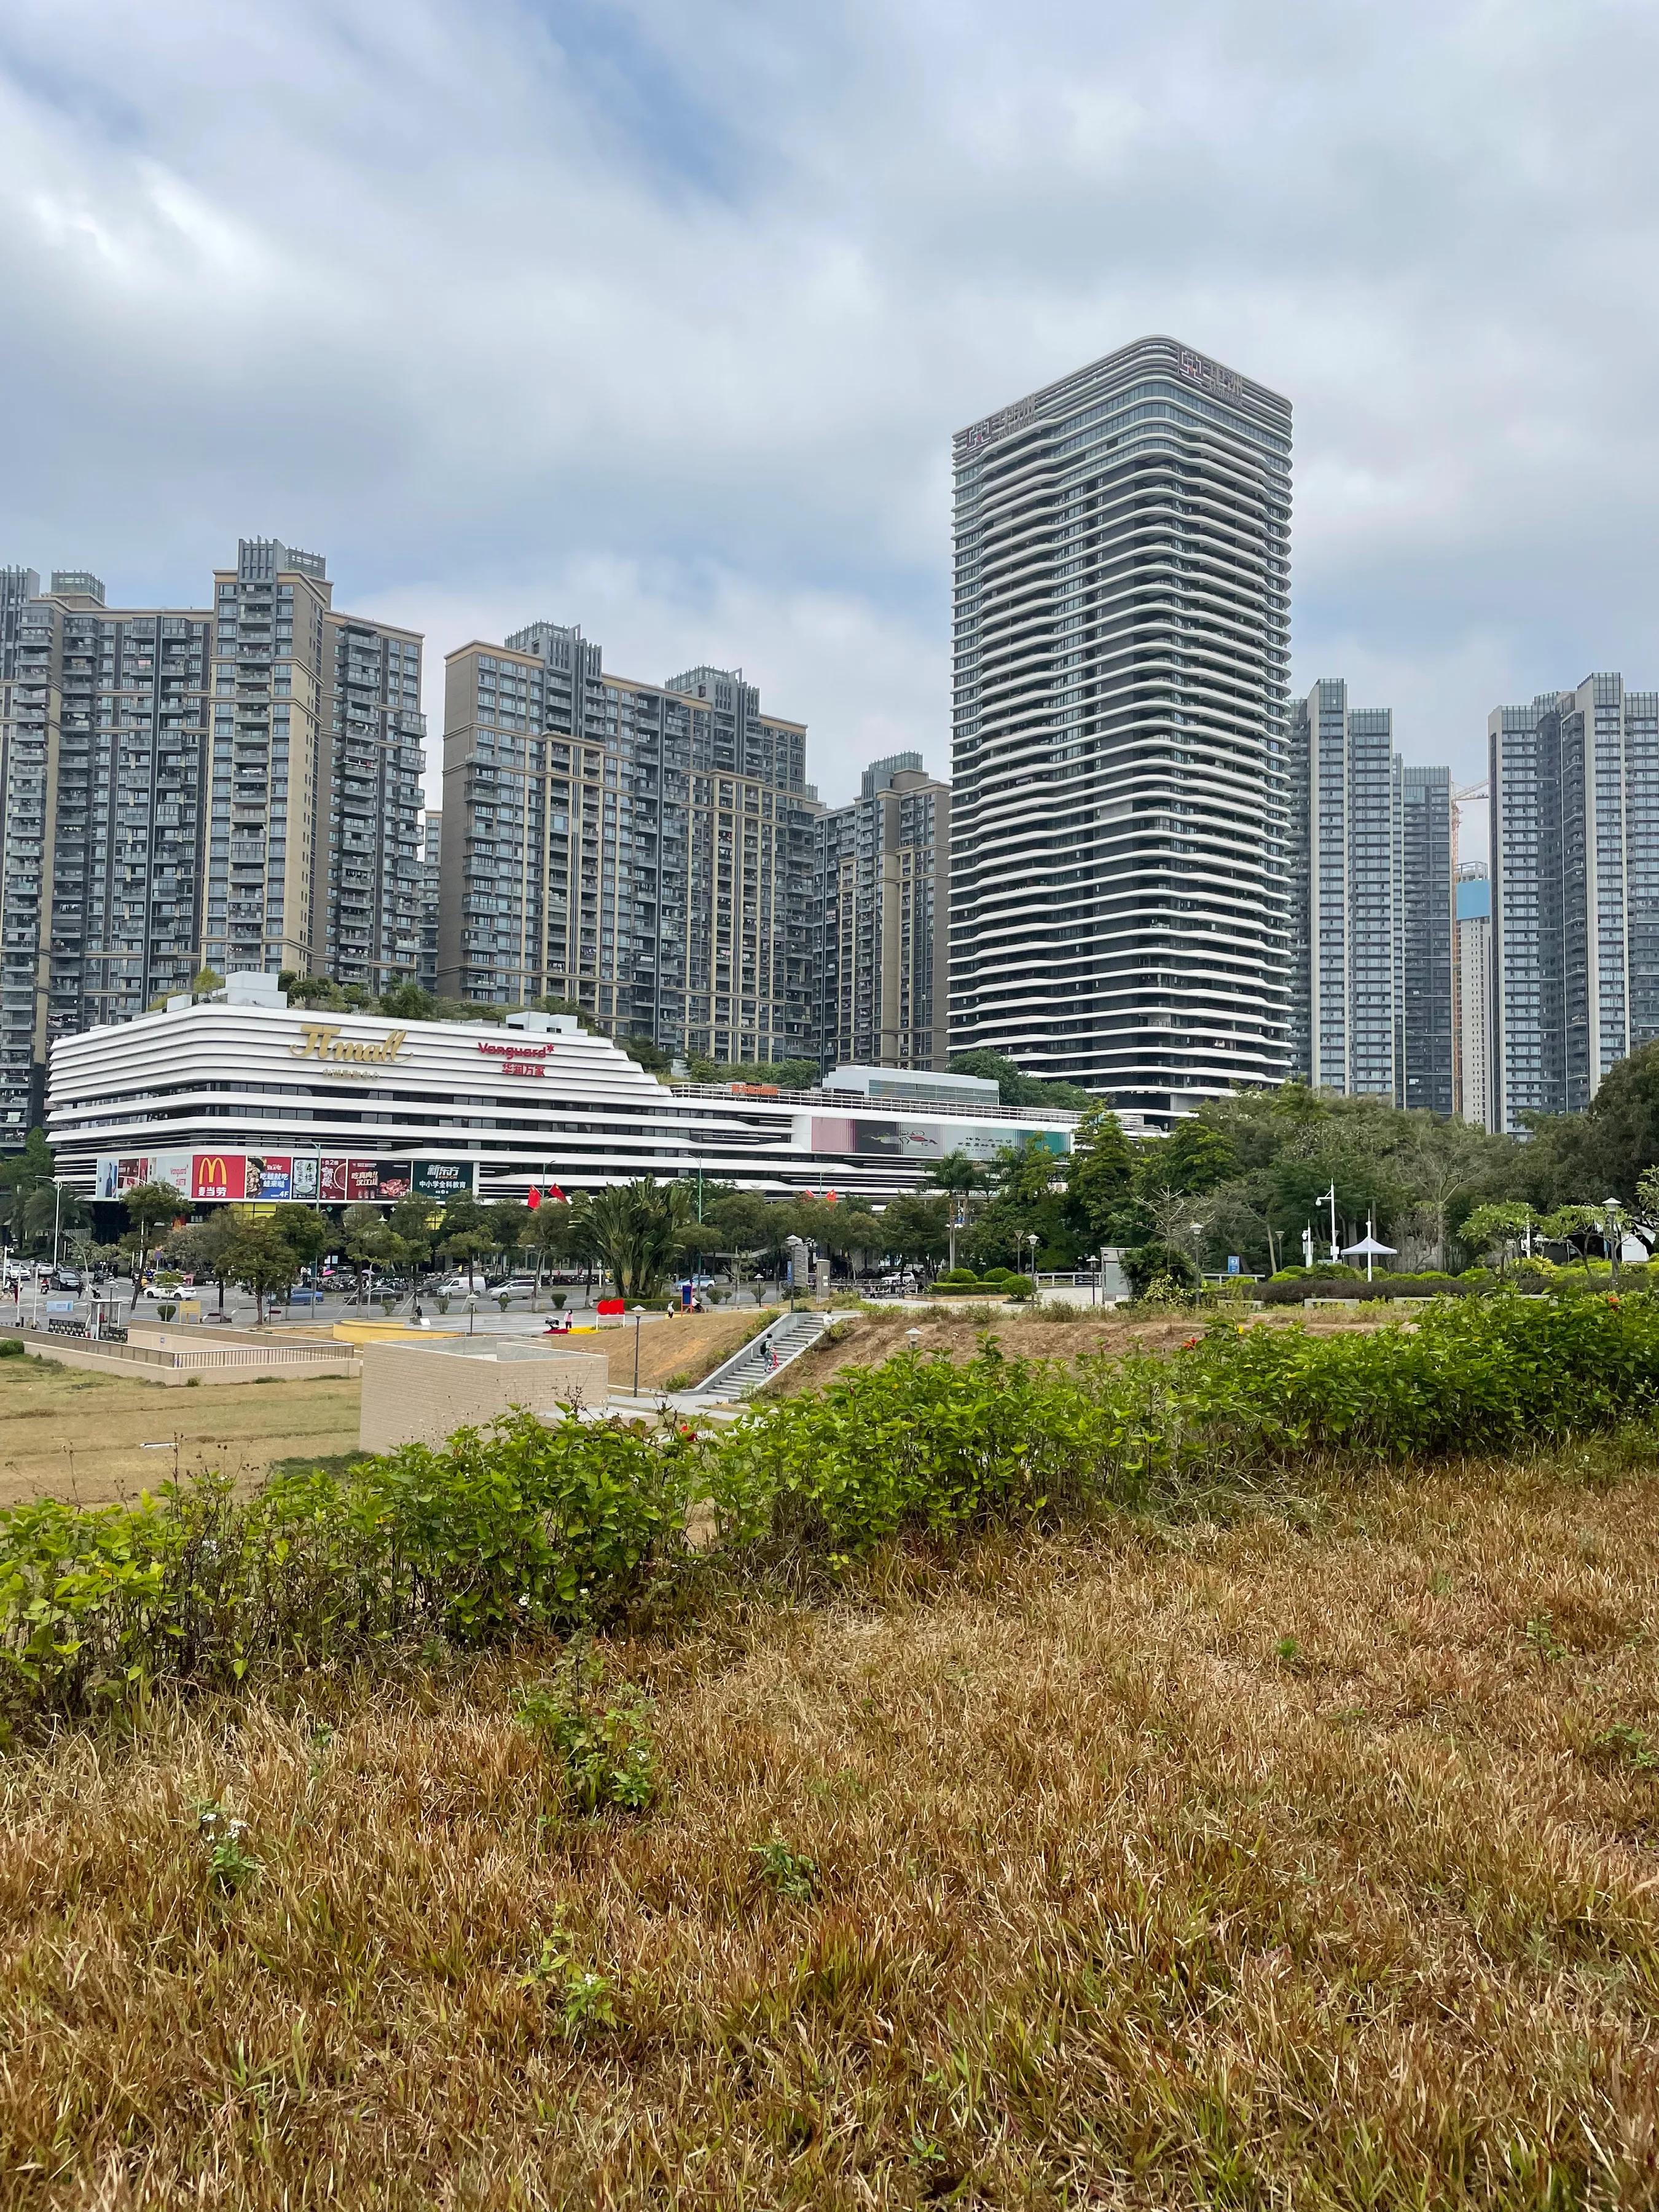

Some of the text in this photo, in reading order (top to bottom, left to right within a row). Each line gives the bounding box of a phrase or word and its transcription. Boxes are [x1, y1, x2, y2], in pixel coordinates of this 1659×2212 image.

[478, 1042, 546, 1060] Vanguard
[502, 1062, 546, 1077] 华润万家
[427, 1164, 460, 1179] 新东方
[198, 1186, 227, 1197] 麦当劳
[419, 1180, 466, 1189] 中小学全科教育
